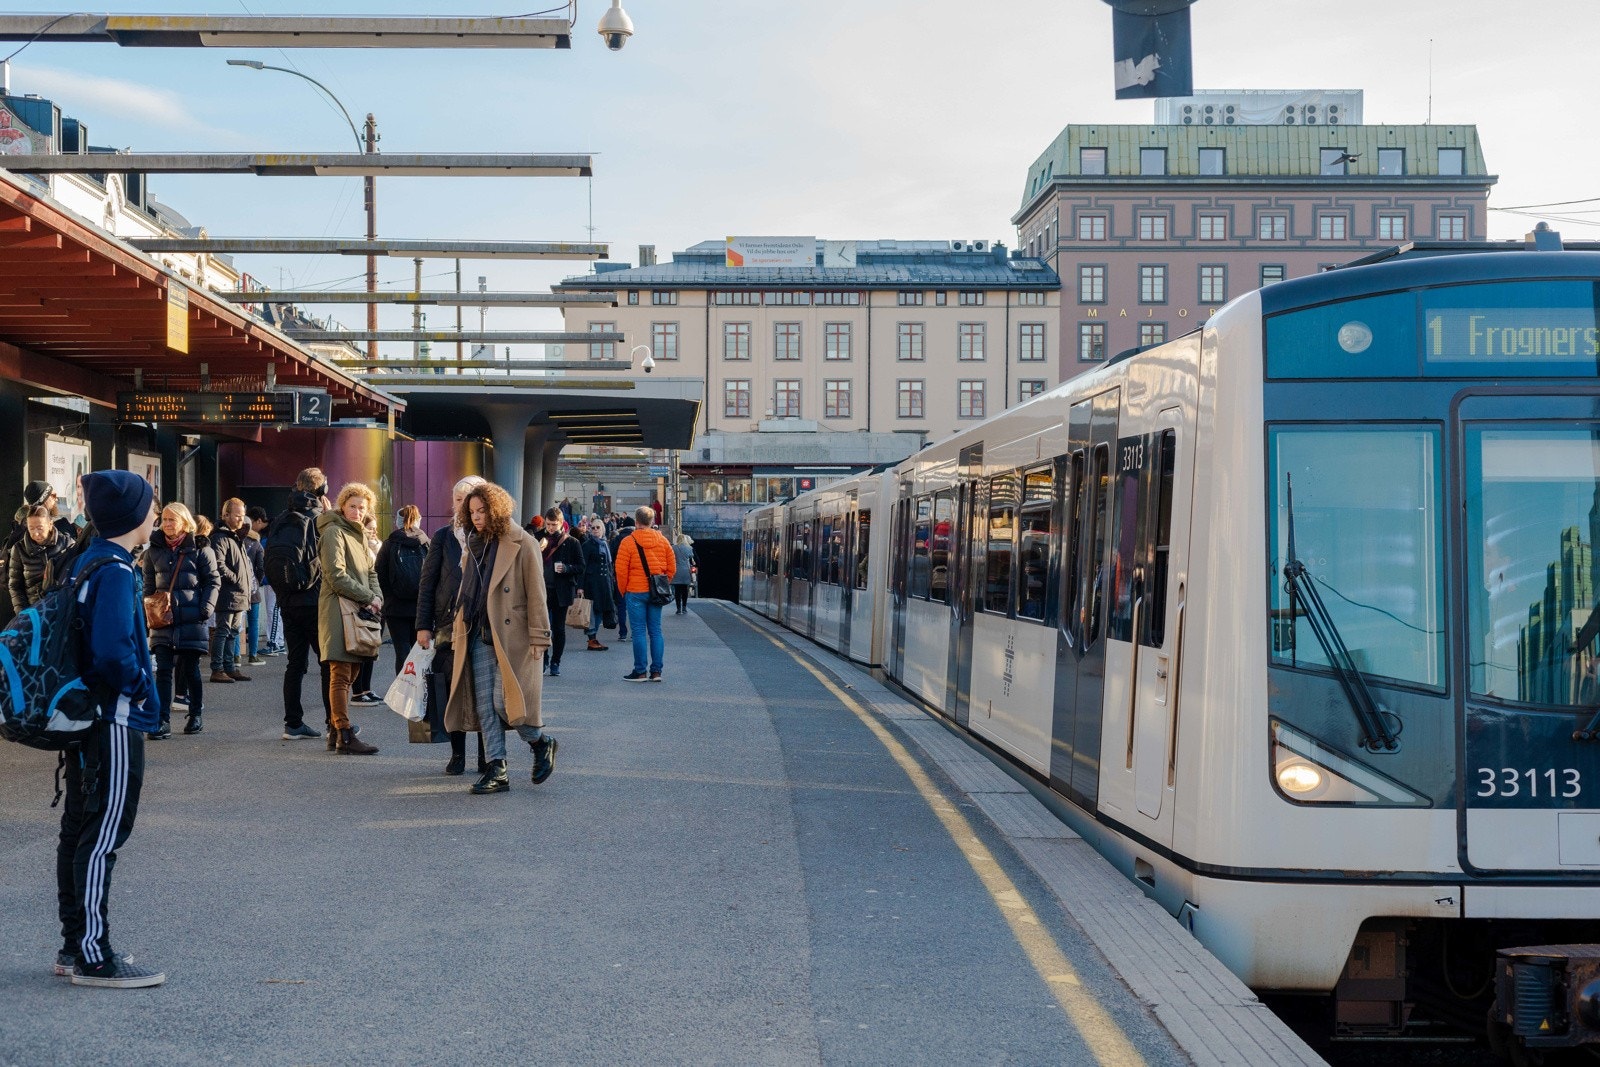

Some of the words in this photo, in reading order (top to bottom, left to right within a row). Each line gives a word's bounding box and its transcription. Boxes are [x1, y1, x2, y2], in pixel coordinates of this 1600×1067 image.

[1429, 316, 1442, 355] 1
[1469, 316, 1600, 355] Frogners
[309, 397, 320, 414] 2
[1123, 444, 1144, 471] 33113
[1477, 767, 1581, 798] 33113
